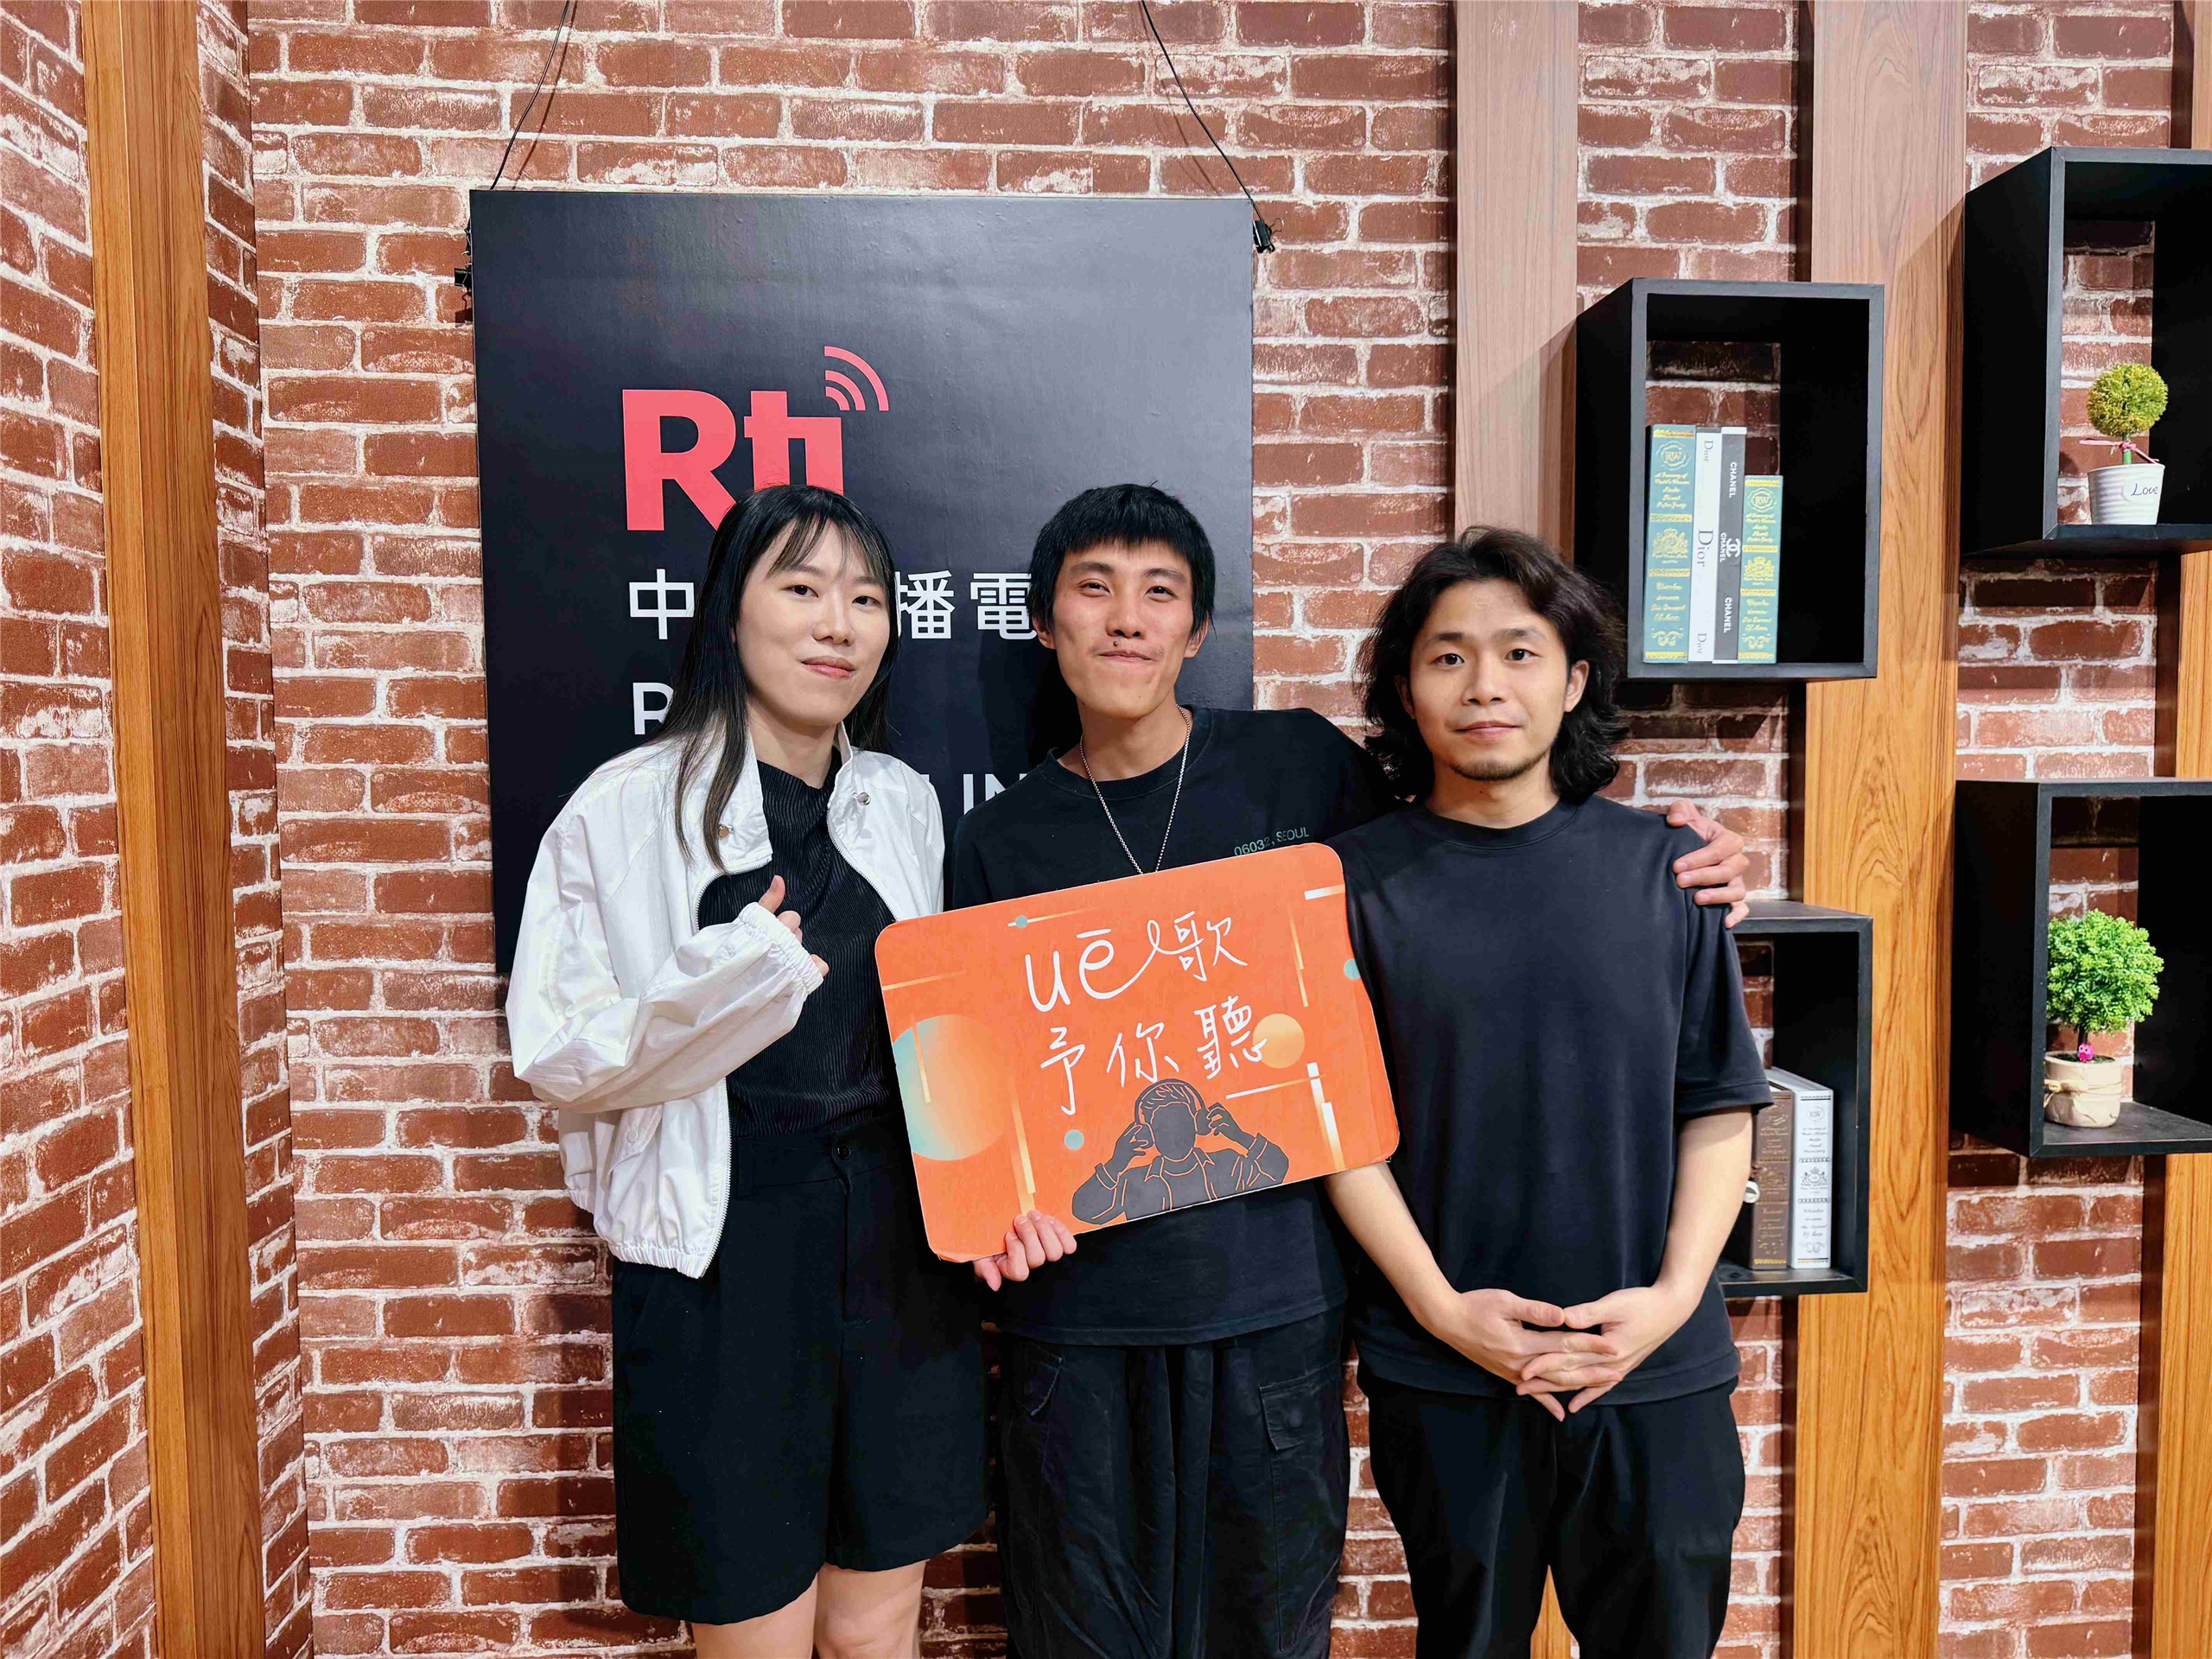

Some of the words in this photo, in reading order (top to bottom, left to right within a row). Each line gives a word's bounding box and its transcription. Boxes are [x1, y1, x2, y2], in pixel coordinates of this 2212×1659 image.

[1704, 440, 1713, 462] Dior
[1729, 461, 1738, 498] CHANEL
[2131, 483, 2158, 496] Love
[1697, 529, 1713, 567] Dior
[1723, 597, 1732, 633] CHANEL
[1696, 632, 1707, 654] Dior
[1276, 827, 1310, 842] SEOUL
